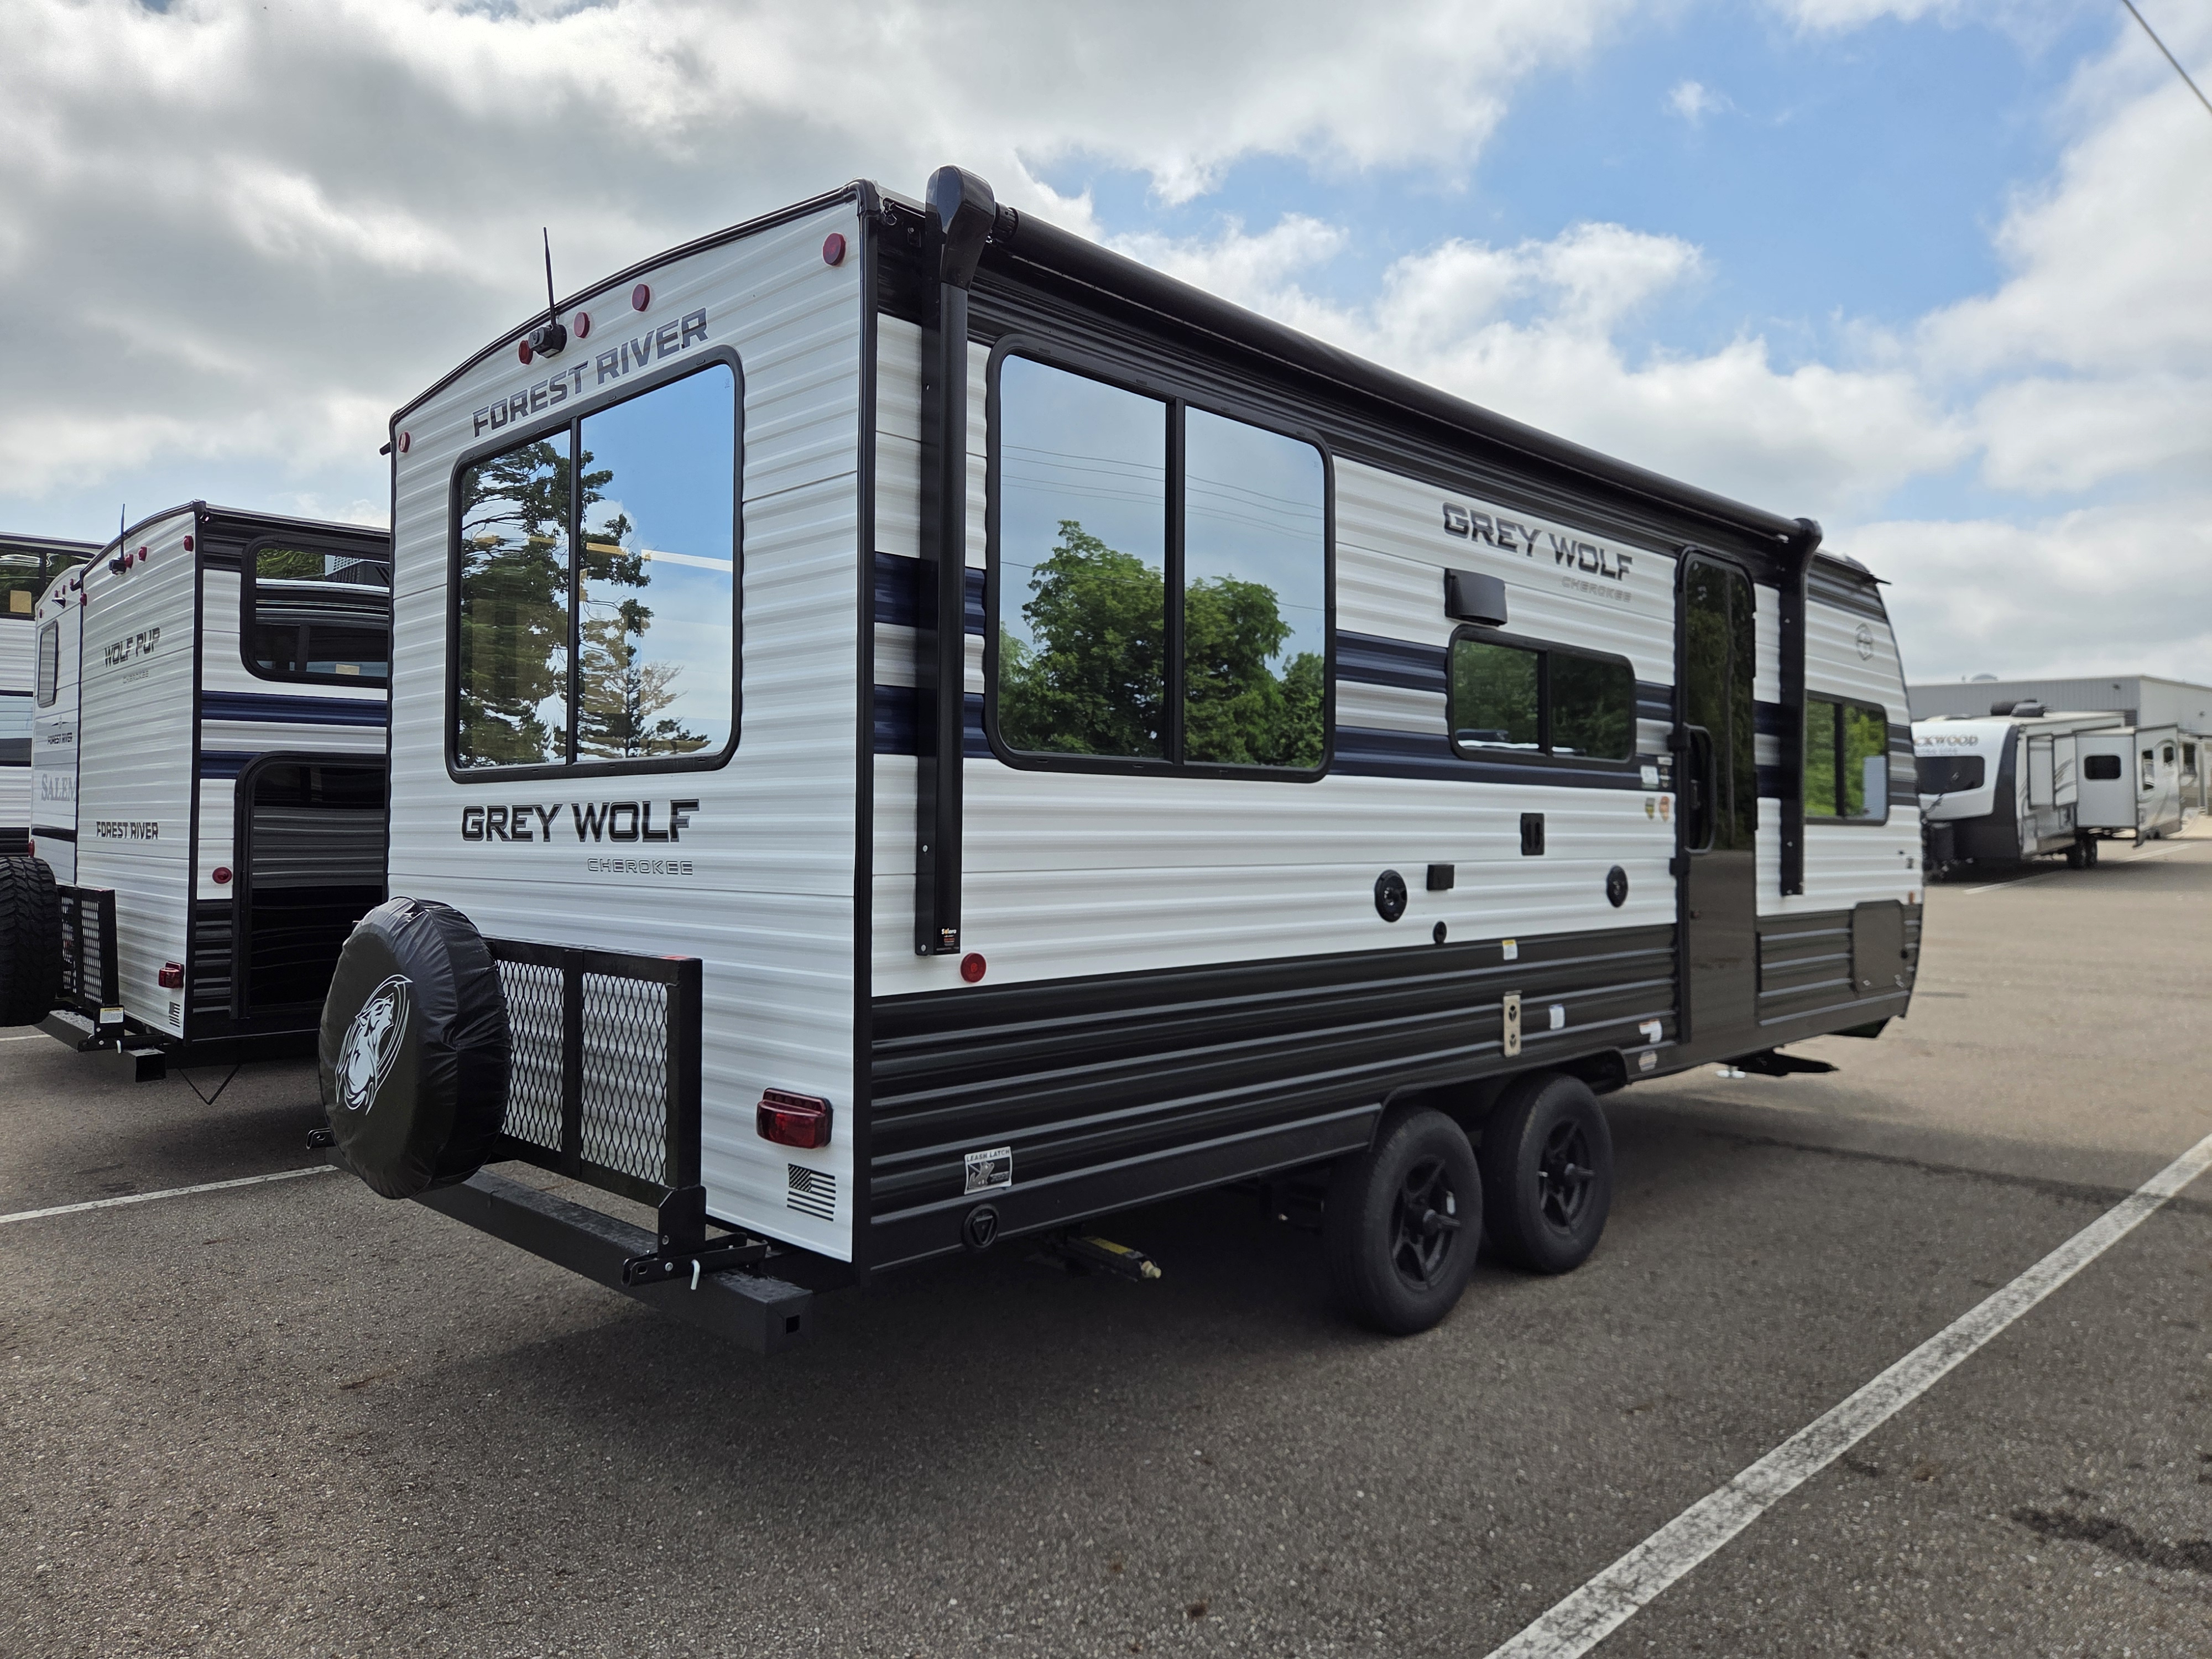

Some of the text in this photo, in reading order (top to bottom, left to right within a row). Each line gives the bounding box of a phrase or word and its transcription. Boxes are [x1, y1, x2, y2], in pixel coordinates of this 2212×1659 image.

[472, 307, 709, 439] FOREST RIVER
[1442, 502, 1633, 581] GREY WOLF
[1561, 576, 1632, 603] CHEROKEE
[104, 627, 160, 668] WOLF PUP
[1913, 734, 1979, 747] CKWOOD
[96, 821, 159, 839] FOREST RIVER
[461, 799, 700, 843] GREY WOLF
[587, 858, 693, 875] CHEROKEE
[967, 1149, 1010, 1162] LEASH LATCH
